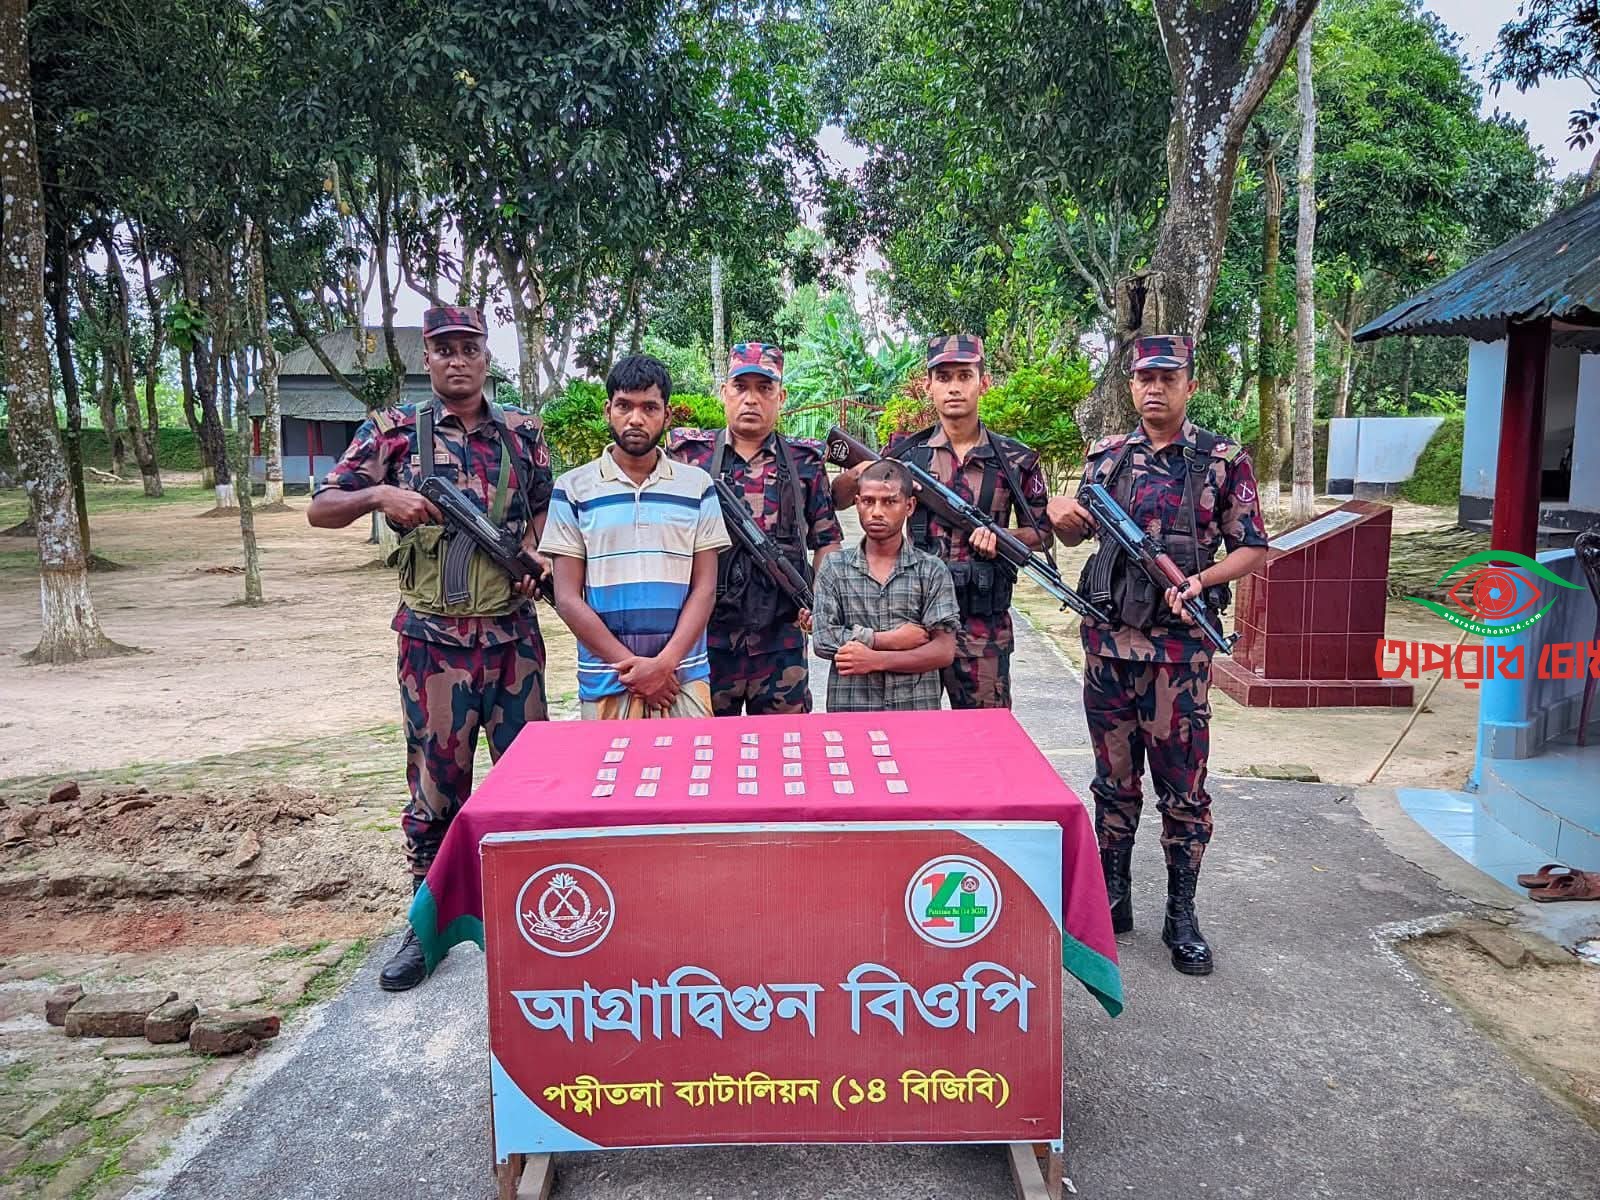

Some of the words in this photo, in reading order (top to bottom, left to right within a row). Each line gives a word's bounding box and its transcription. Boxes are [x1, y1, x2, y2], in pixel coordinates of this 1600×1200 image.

[510, 966, 824, 1043] আগ্রাদ্বিগুন
[838, 961, 1036, 1037] বিওপি
[543, 1074, 664, 1117] পত্নীতলা
[672, 1071, 820, 1107] ব্যাটালিয়ন
[832, 1075, 887, 1111] (১৪
[898, 1068, 1010, 1109] বিজিবি)
